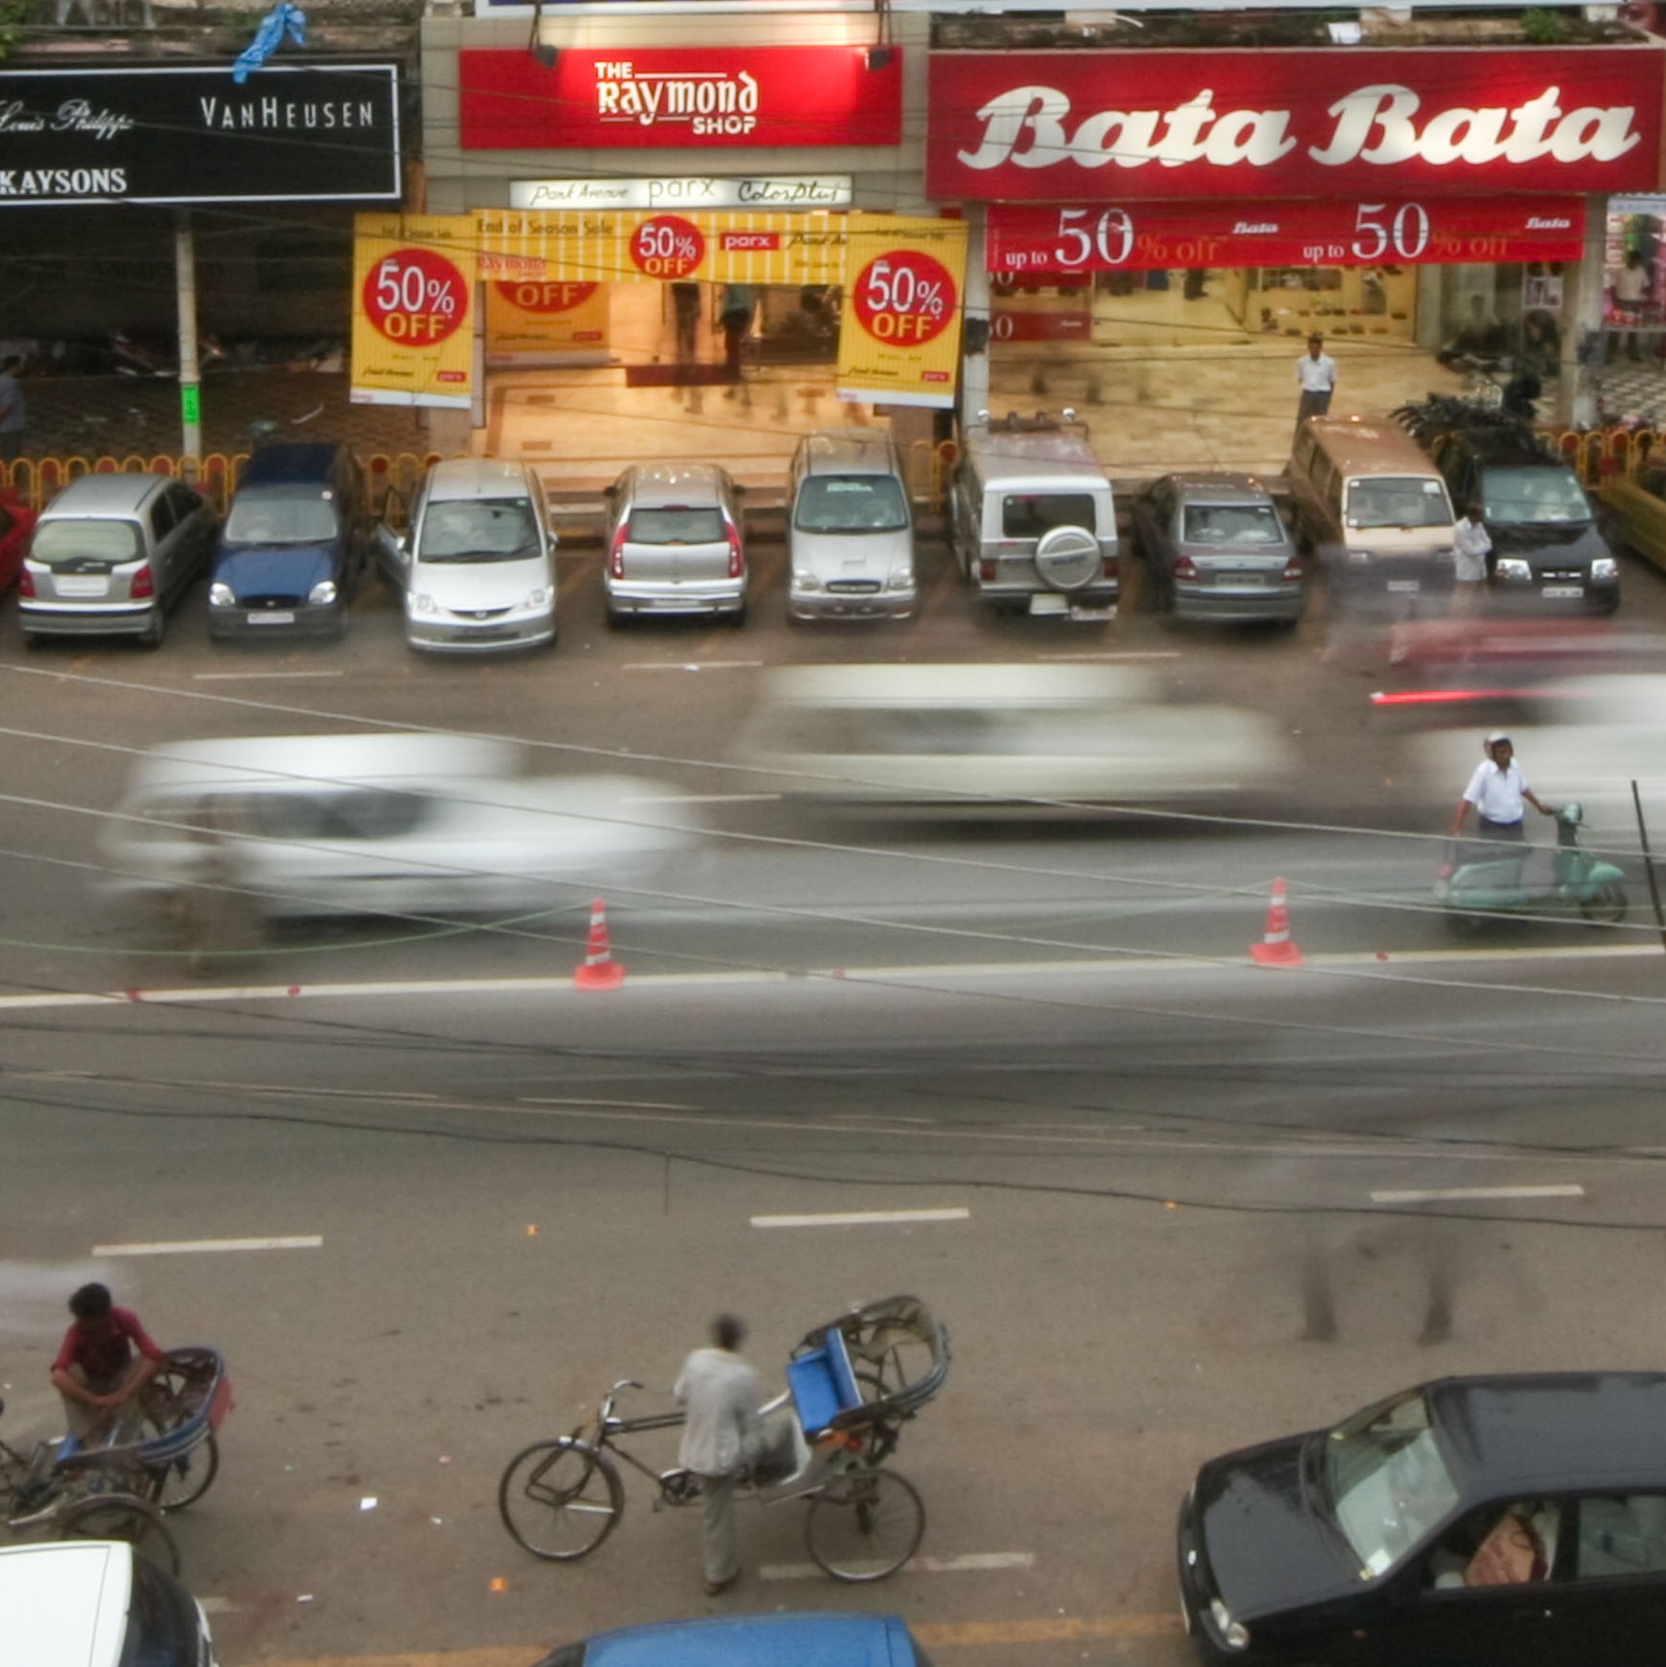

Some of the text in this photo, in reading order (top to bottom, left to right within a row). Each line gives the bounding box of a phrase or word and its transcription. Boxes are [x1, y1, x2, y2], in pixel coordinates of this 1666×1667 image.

[594, 62, 633, 79] THE
[596, 70, 758, 126] Raymond
[693, 116, 757, 135] SHOP
[957, 84, 1641, 170] Bata Bata
[530, 183, 629, 205] Park Avenue
[648, 178, 716, 207] parx
[477, 218, 613, 234] End of Season Sale
[1232, 222, 1279, 234] Bata
[1525, 217, 1570, 229] Bata
[639, 227, 696, 260] 50%
[724, 235, 770, 251] parx
[1303, 245, 1324, 262] up
[1327, 244, 1344, 258] to
[645, 258, 689, 275] OFF
[1006, 252, 1027, 269] up
[1031, 251, 1048, 265] to
[377, 265, 454, 314] 50%
[516, 285, 578, 306] OFF
[866, 267, 943, 314] 50%
[384, 312, 445, 338] OFF
[872, 313, 933, 339] OFF
